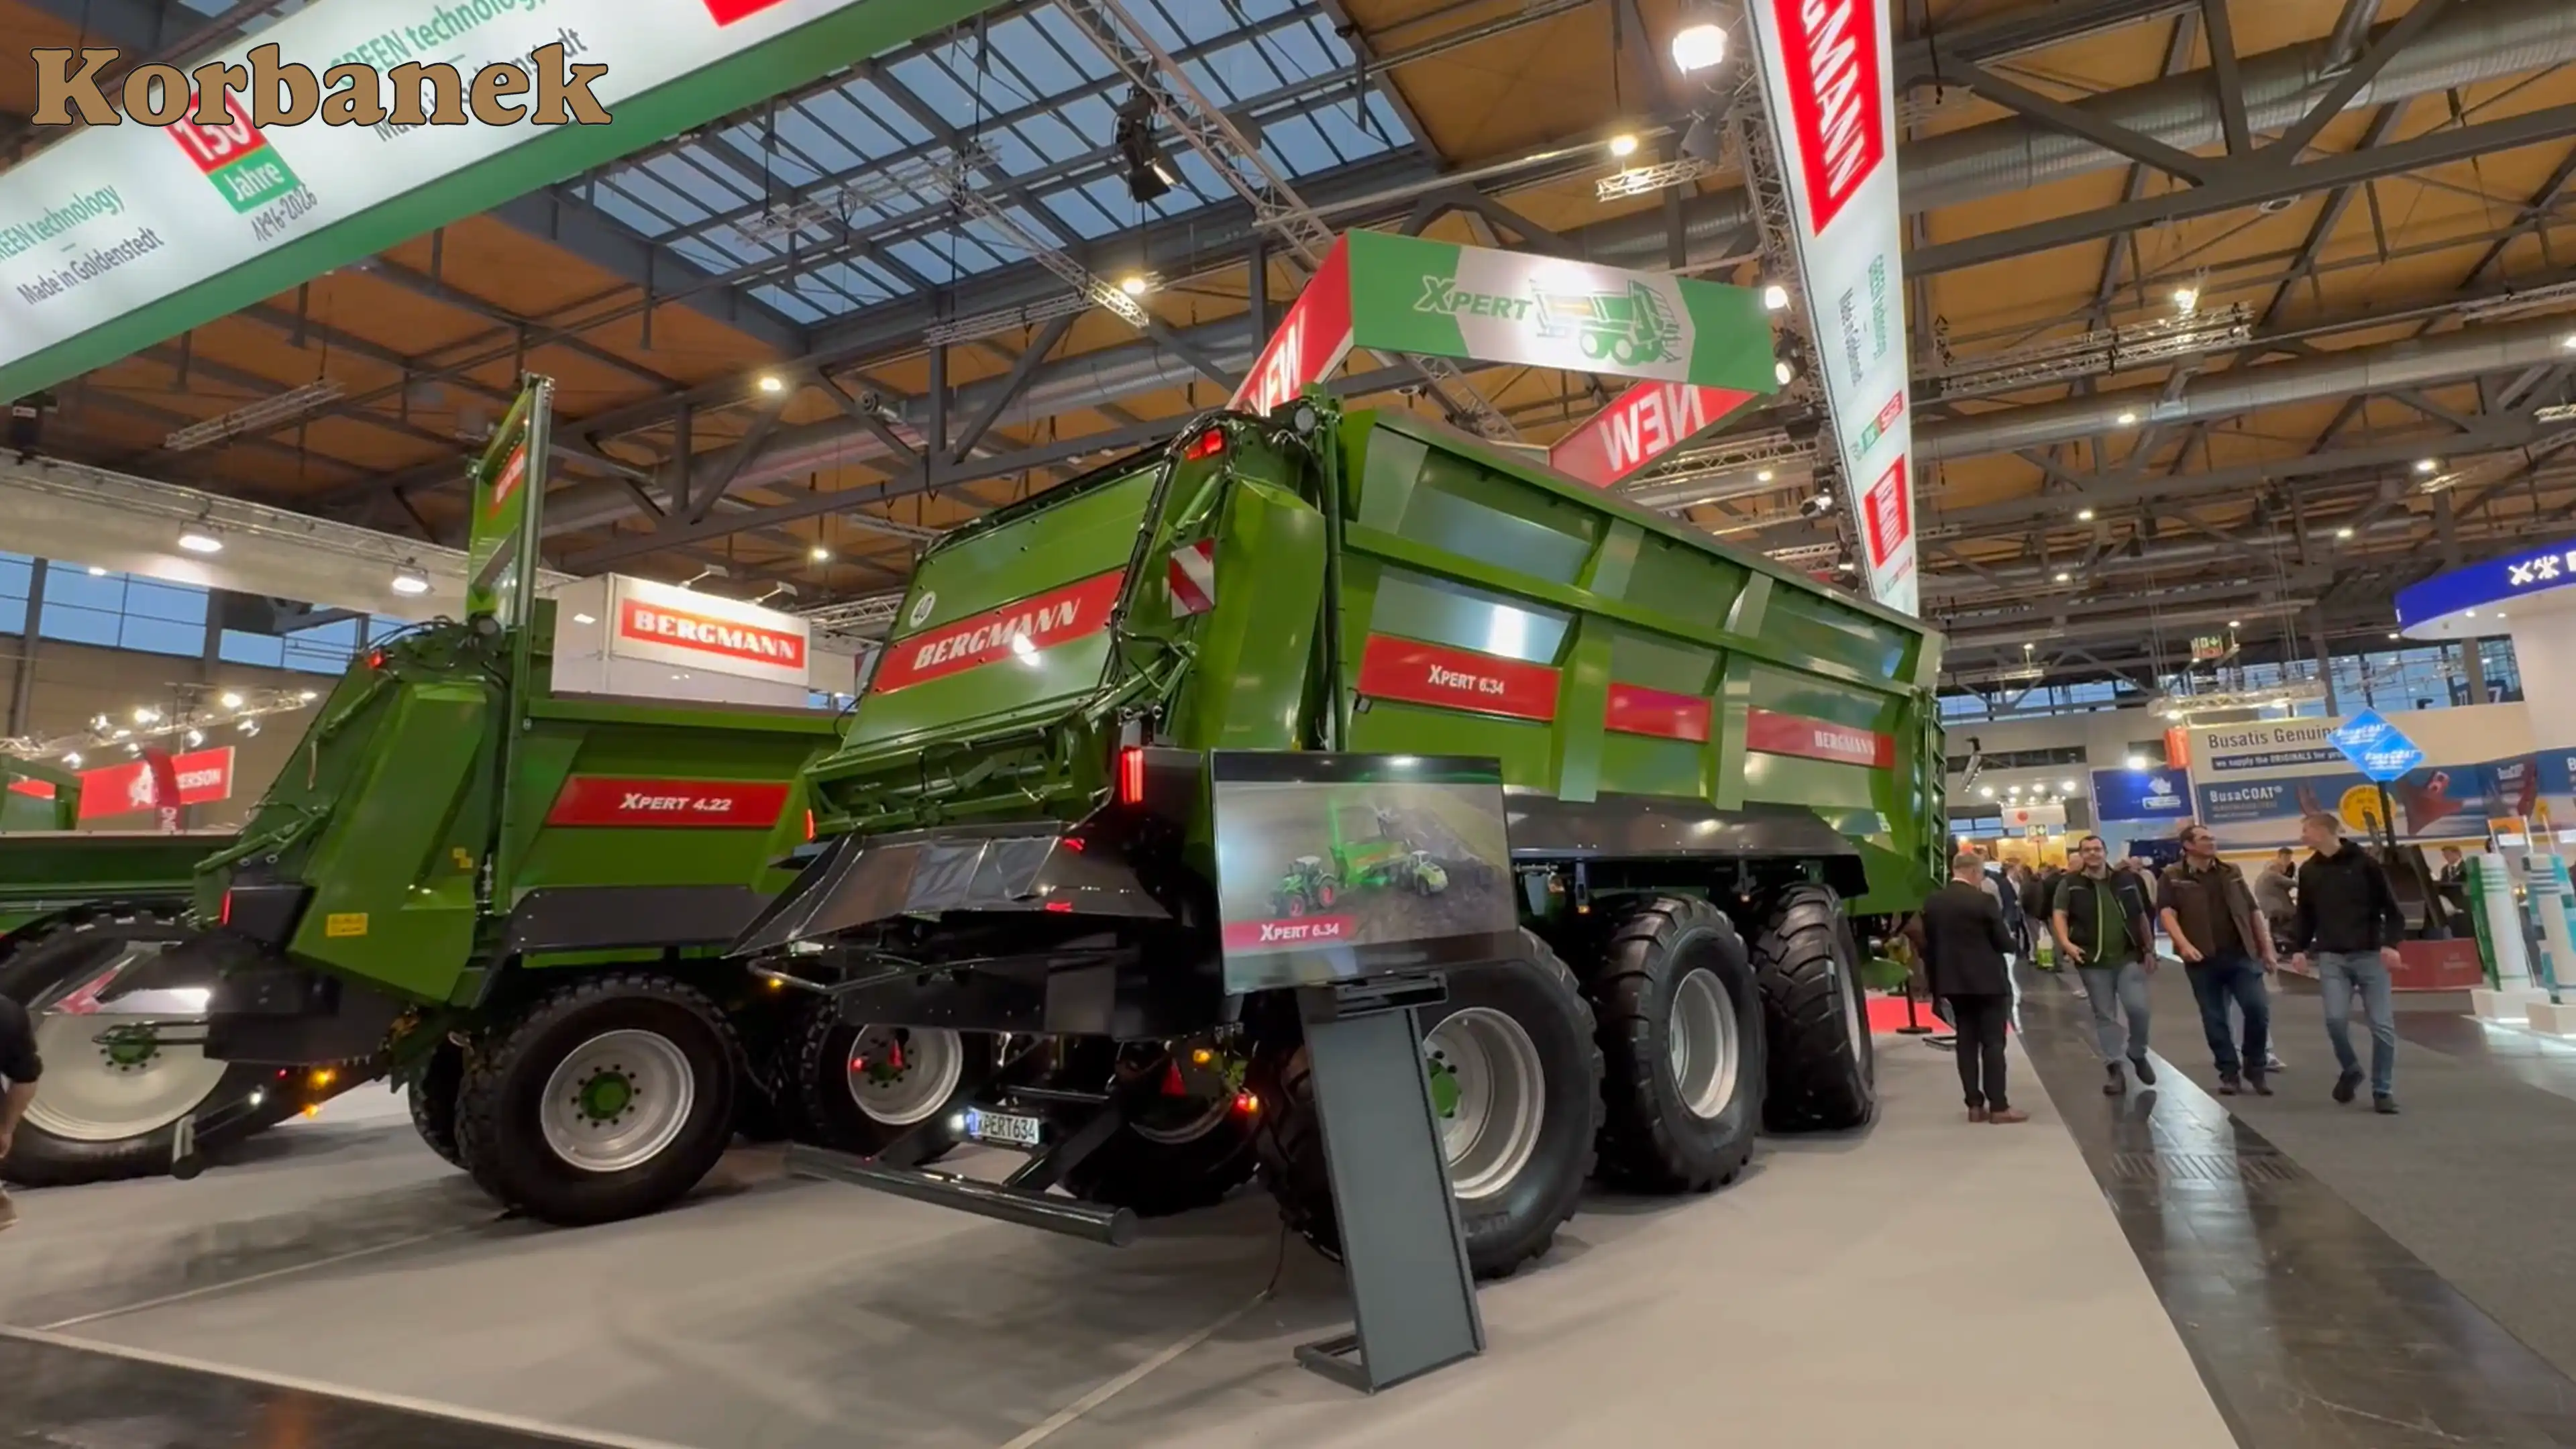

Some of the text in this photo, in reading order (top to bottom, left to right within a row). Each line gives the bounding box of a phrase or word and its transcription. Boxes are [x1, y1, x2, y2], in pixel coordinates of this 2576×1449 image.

[223, 162, 285, 201] Jahre
[27, 184, 125, 241] technology
[250, 182, 319, 242] 1896-2026
[16, 226, 165, 305] Made in Goldenstedt
[633, 608, 796, 660] BERGMANN
[912, 597, 1081, 671] BERGMANN
[1479, 677, 1505, 695] 6.34
[2208, 731, 2269, 749] Busatis
[2273, 725, 2338, 743] Genuin
[692, 797, 733, 812] 4.22
[1311, 922, 1340, 936] 6.34
